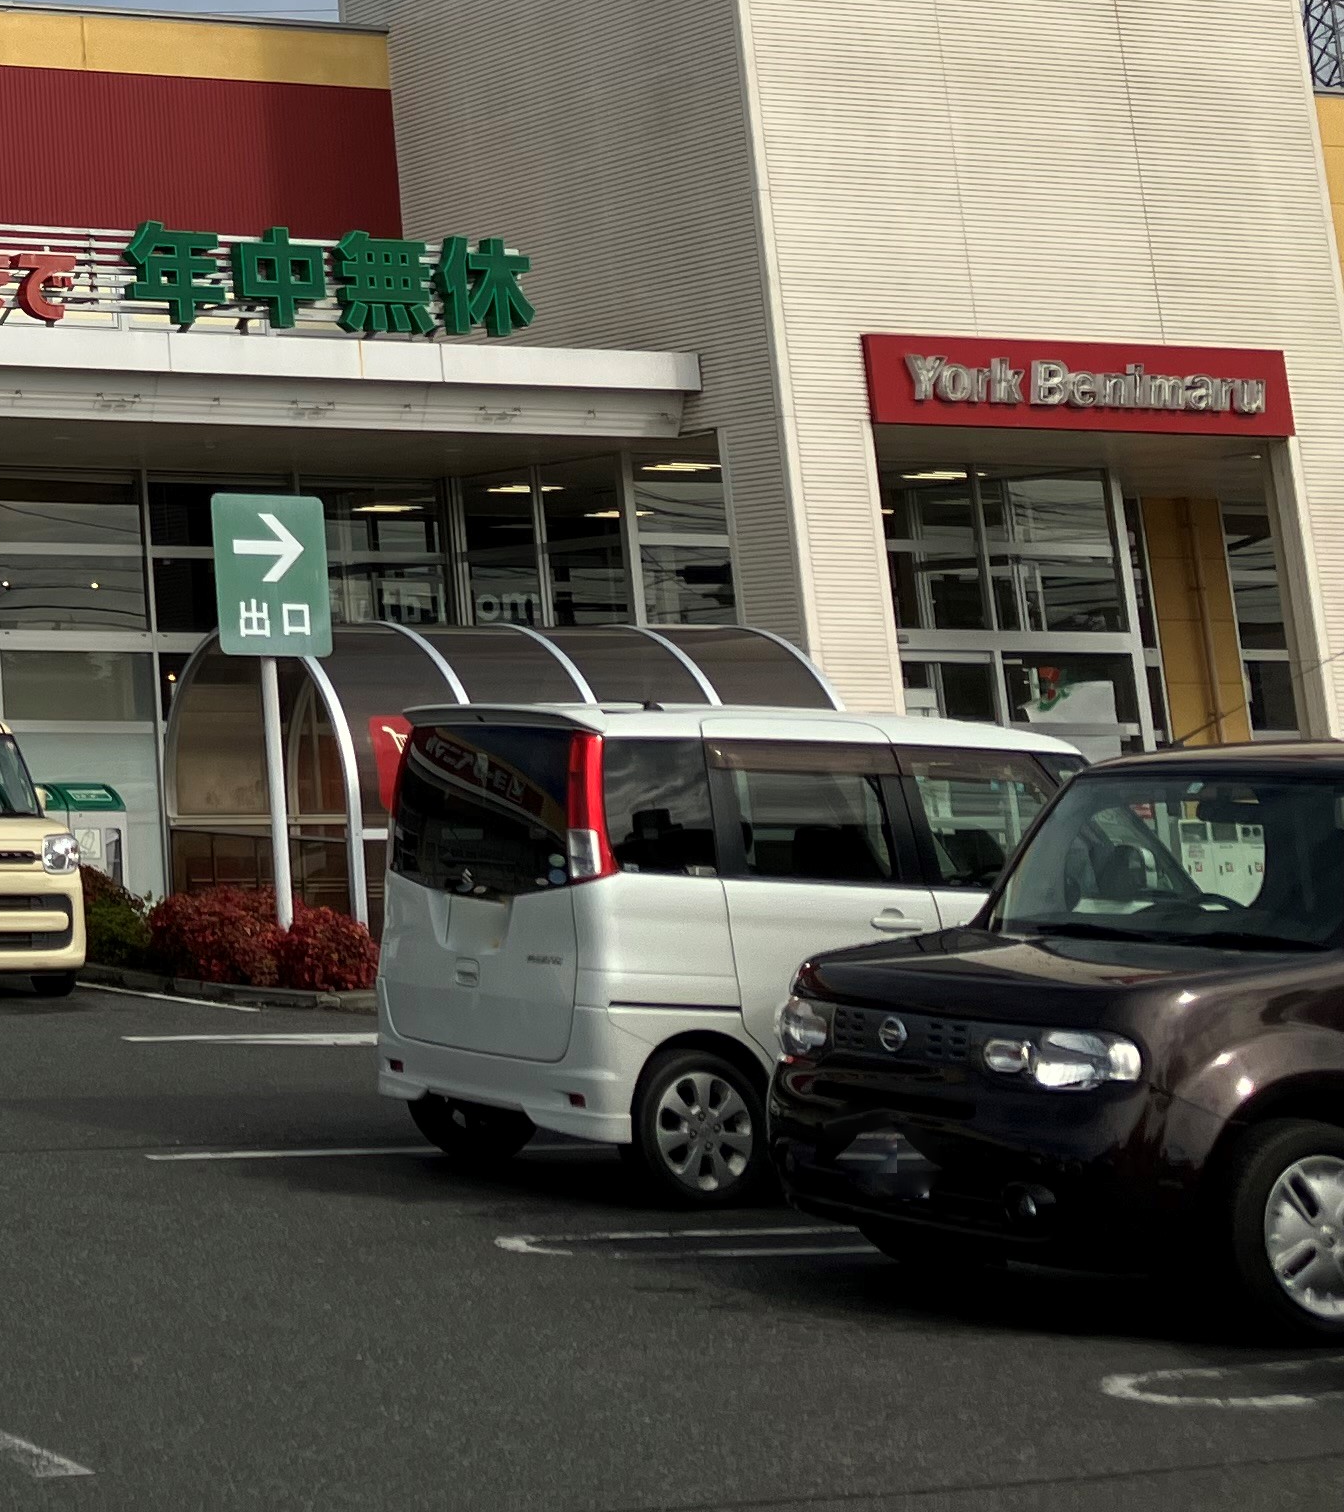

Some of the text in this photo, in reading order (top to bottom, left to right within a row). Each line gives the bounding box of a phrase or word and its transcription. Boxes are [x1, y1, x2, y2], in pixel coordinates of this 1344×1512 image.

[122, 220, 536, 336] 年中無休
[904, 352, 1266, 414] York Benimaru
[238, 597, 311, 639] 出口
